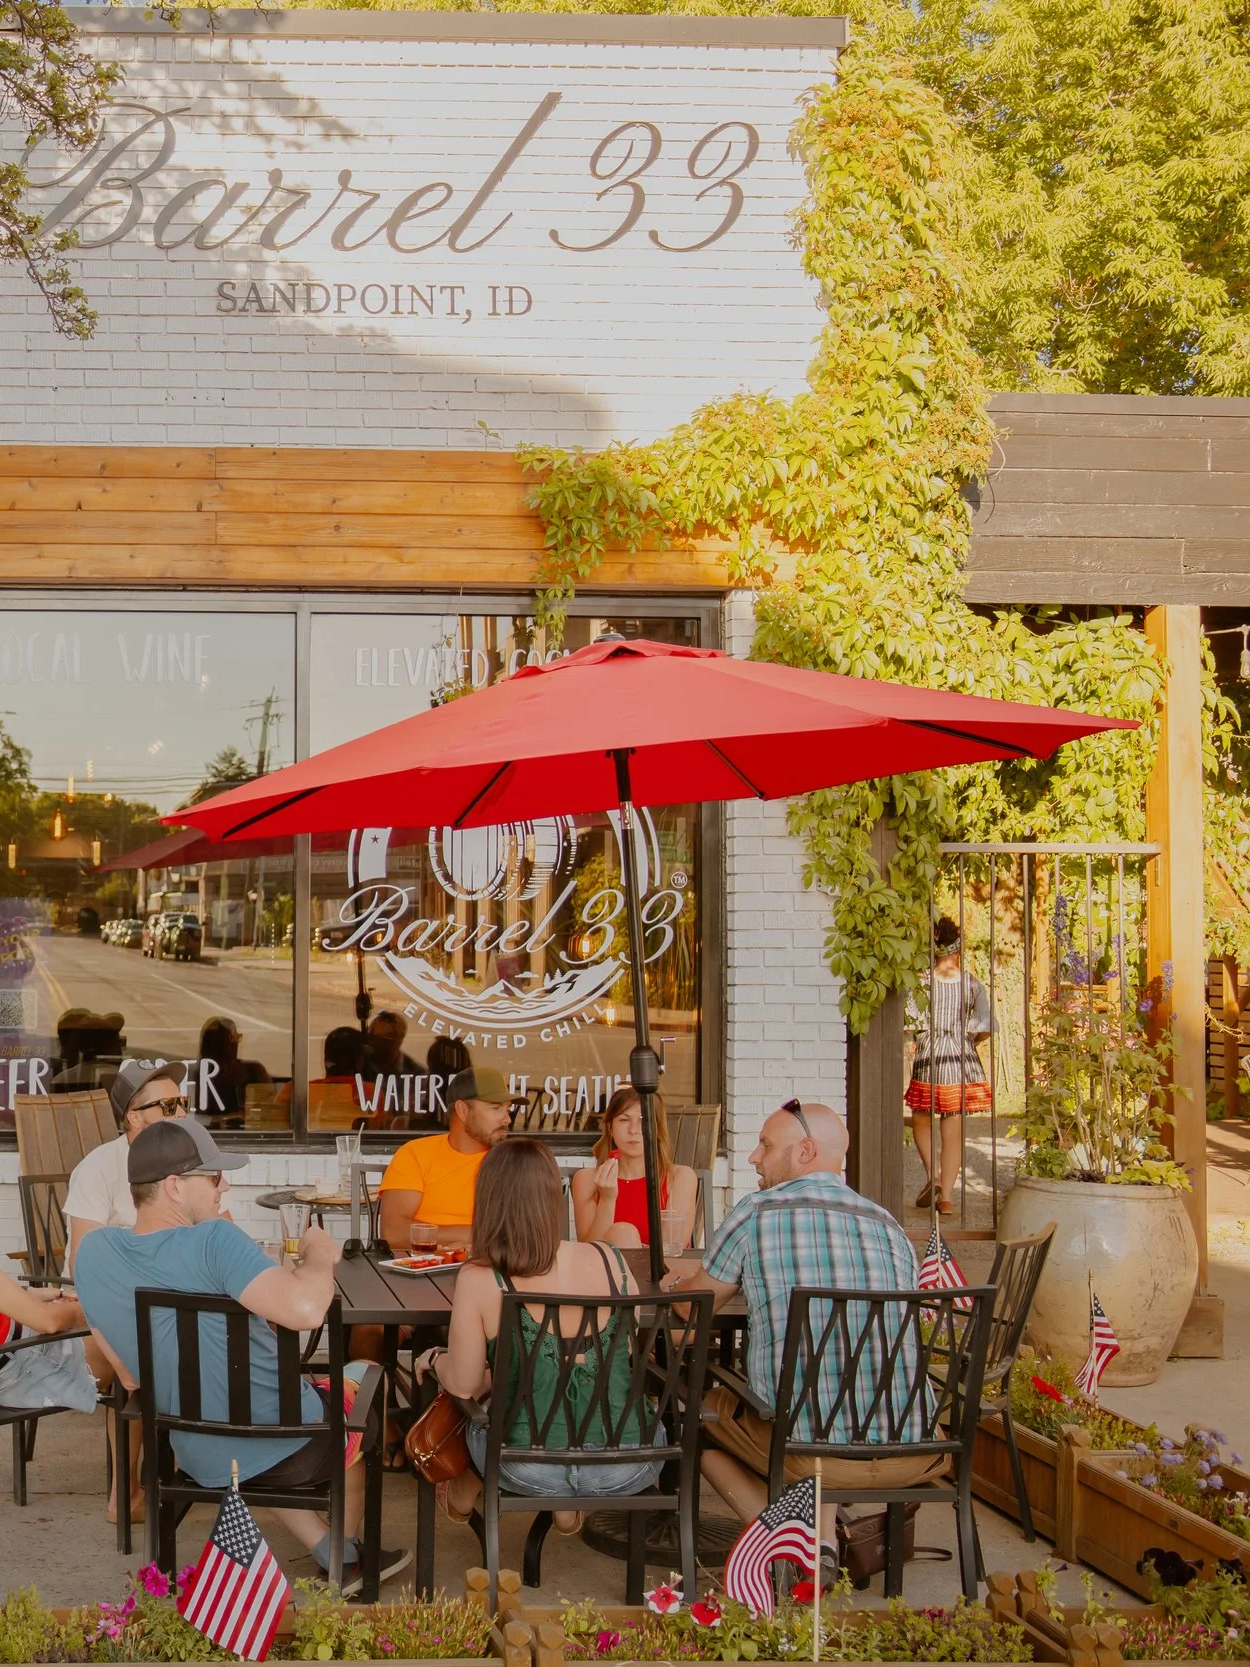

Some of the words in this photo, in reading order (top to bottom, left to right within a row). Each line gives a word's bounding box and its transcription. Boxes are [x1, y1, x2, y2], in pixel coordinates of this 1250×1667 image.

[18, 91, 563, 254] Barrel
[549, 120, 761, 253] 33
[217, 279, 472, 324] SANDPOINT,
[488, 284, 534, 317] ID
[117, 631, 211, 685] WINE
[354, 646, 490, 688] ELEVATED
[323, 880, 578, 953] Barrel
[558, 888, 685, 966] 33
[402, 1001, 528, 1050] ELEVATED
[540, 1002, 607, 1043] CHILL
